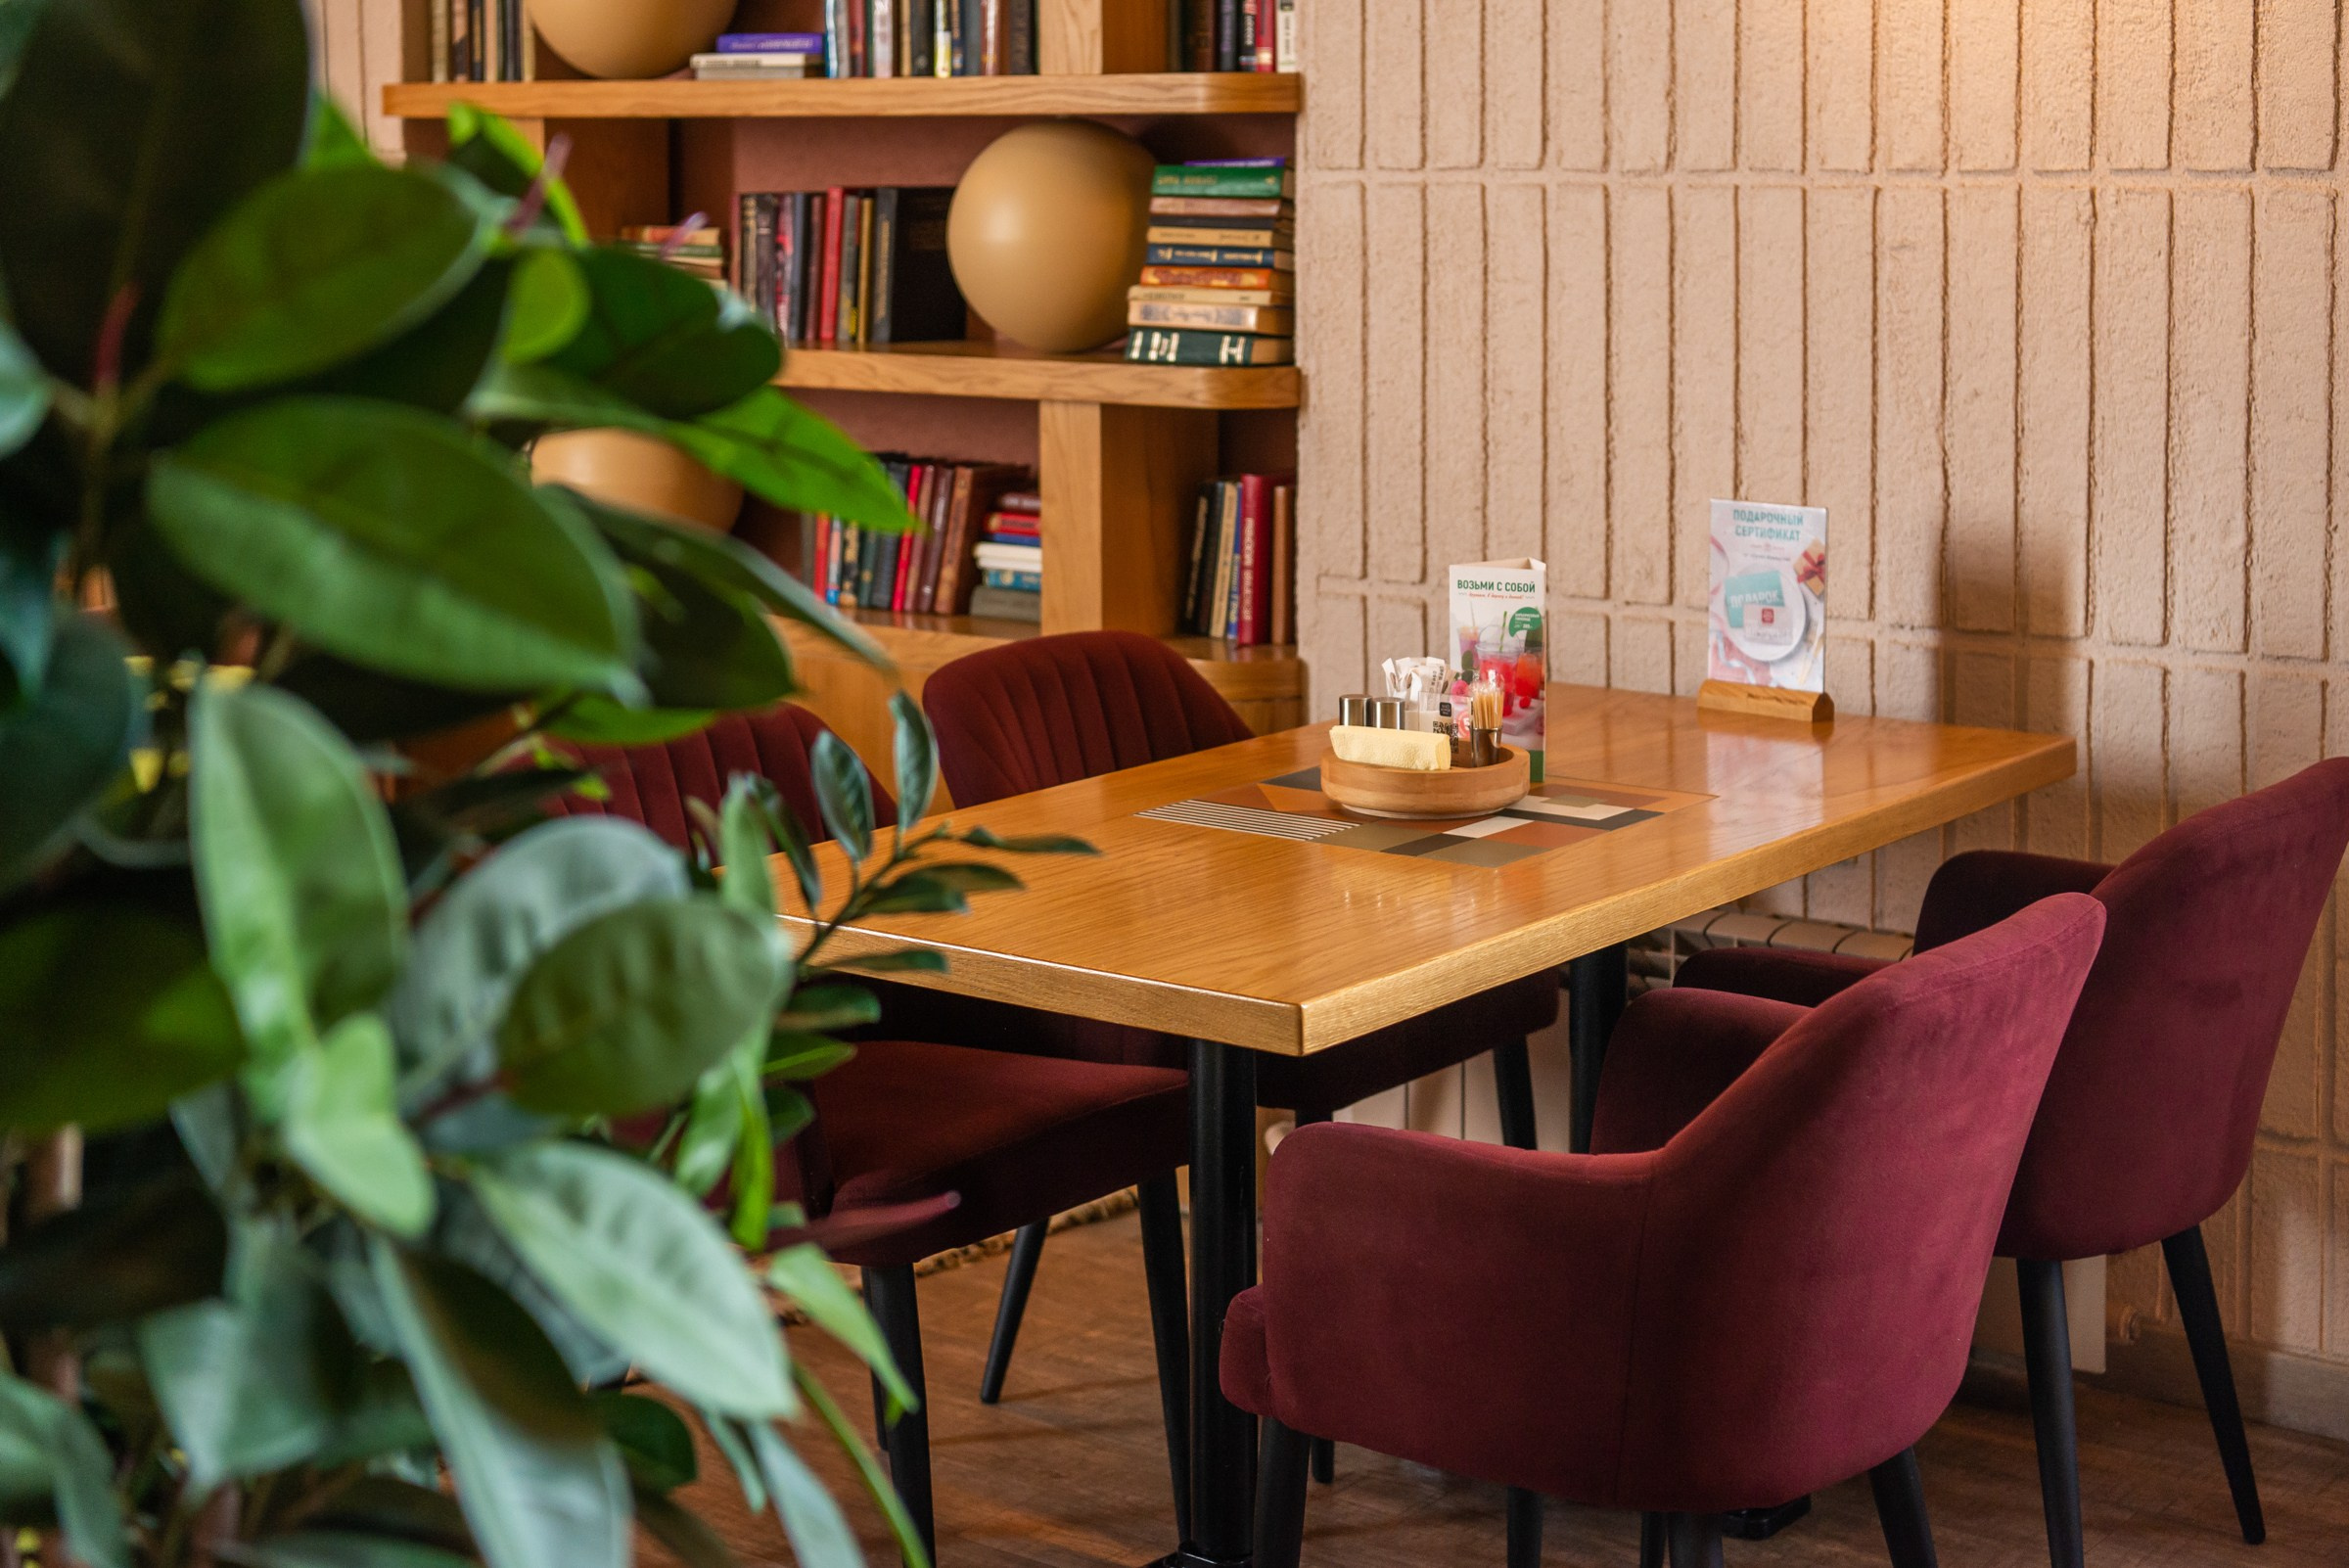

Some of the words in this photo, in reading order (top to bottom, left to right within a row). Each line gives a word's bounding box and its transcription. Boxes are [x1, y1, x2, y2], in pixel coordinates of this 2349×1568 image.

[1732, 508, 1804, 526] ПОДАРОЧНЫЙ
[1734, 525, 1801, 541] СЕРТИФИКАТ
[1457, 579, 1495, 591] ВОЗЬМИ
[1497, 581, 1502, 591] С
[1504, 580, 1536, 593] СОБОЙ
